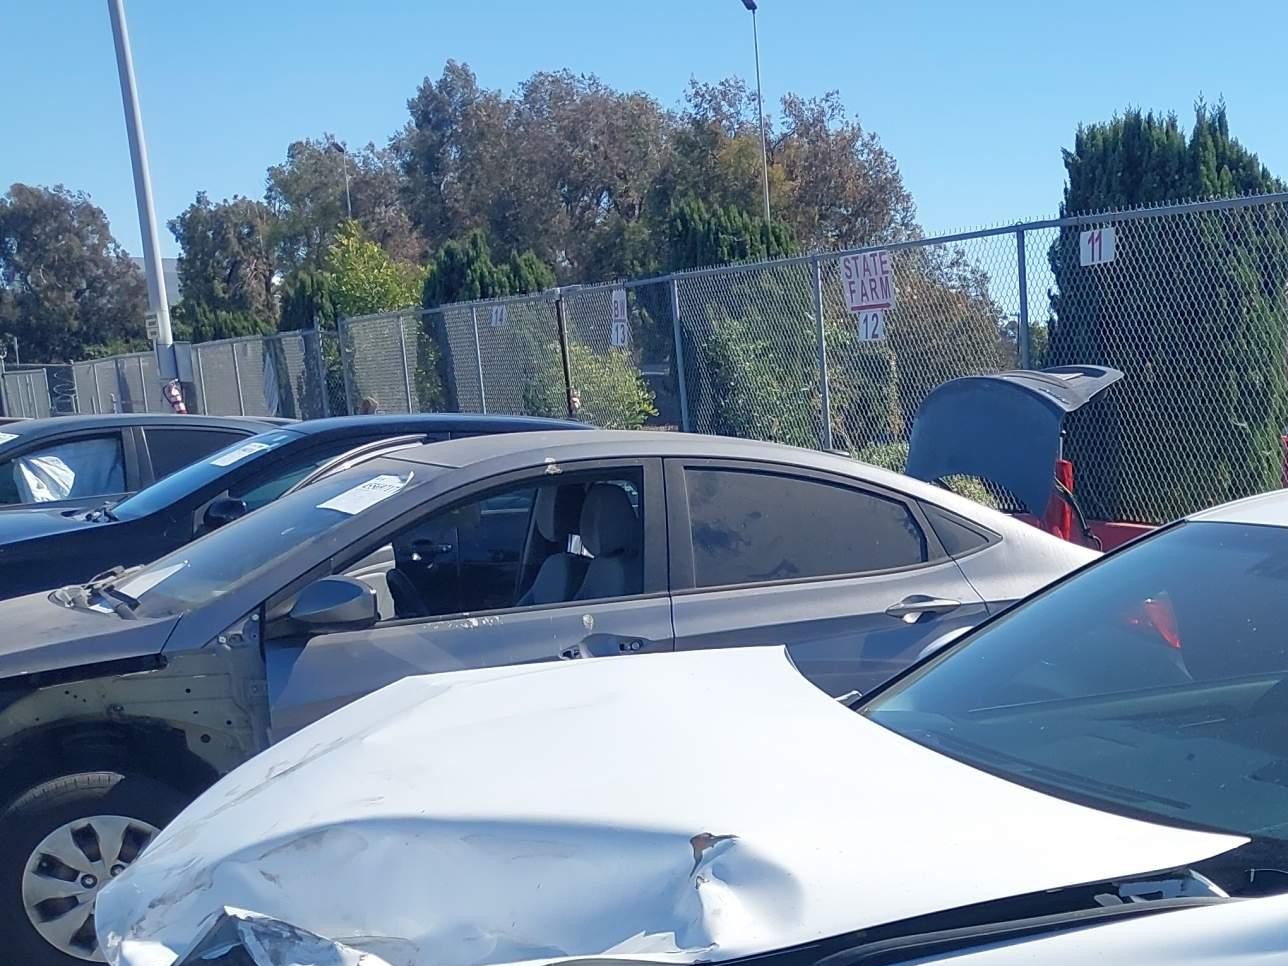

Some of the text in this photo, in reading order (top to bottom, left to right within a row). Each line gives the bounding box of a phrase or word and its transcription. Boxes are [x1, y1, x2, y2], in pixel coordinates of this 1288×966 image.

[1087, 231, 1103, 262] 11
[843, 251, 890, 280] STATE
[848, 276, 892, 304] FARM
[614, 323, 627, 345] 13
[862, 312, 880, 340] 12
